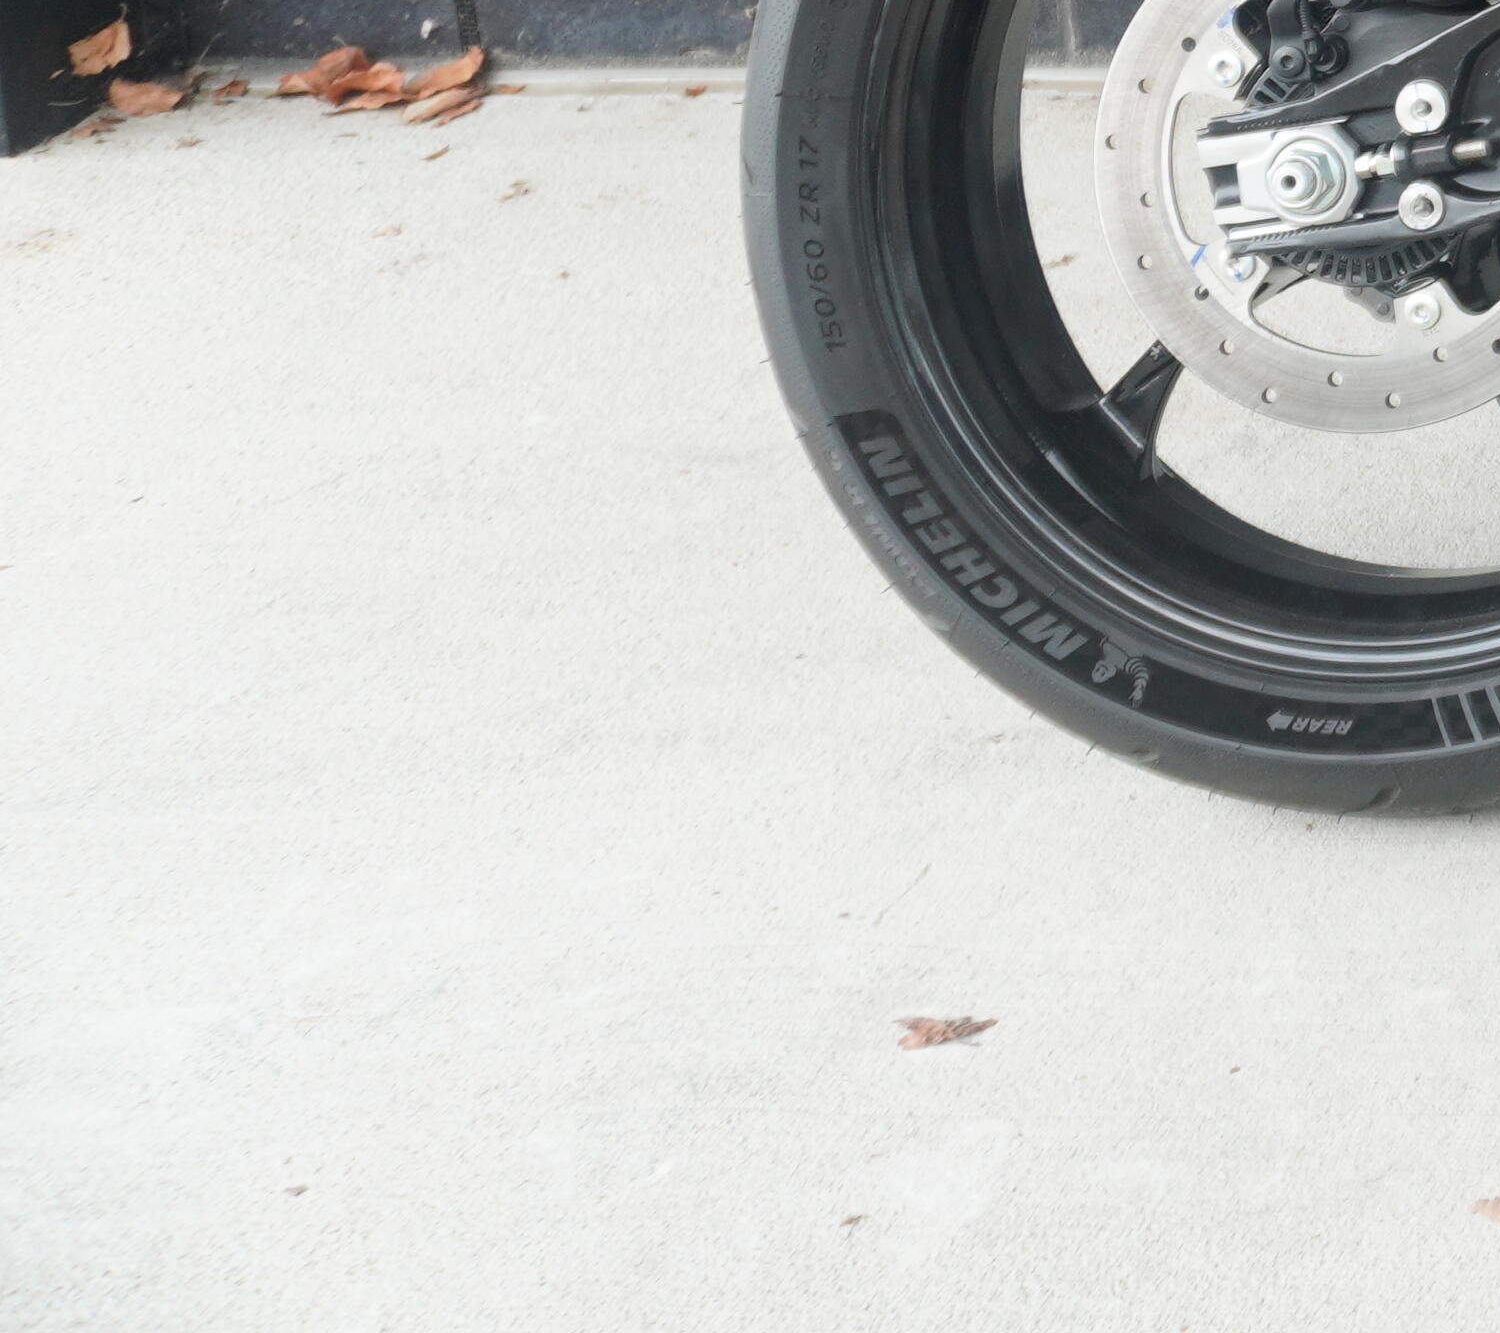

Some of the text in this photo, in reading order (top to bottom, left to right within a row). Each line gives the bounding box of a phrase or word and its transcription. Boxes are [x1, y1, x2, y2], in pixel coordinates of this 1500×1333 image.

[799, 135, 819, 172] 17
[799, 183, 821, 227] ZR
[802, 238, 847, 354] 150/60
[857, 435, 1090, 662] MICHELIN
[1291, 715, 1354, 736] REAR
